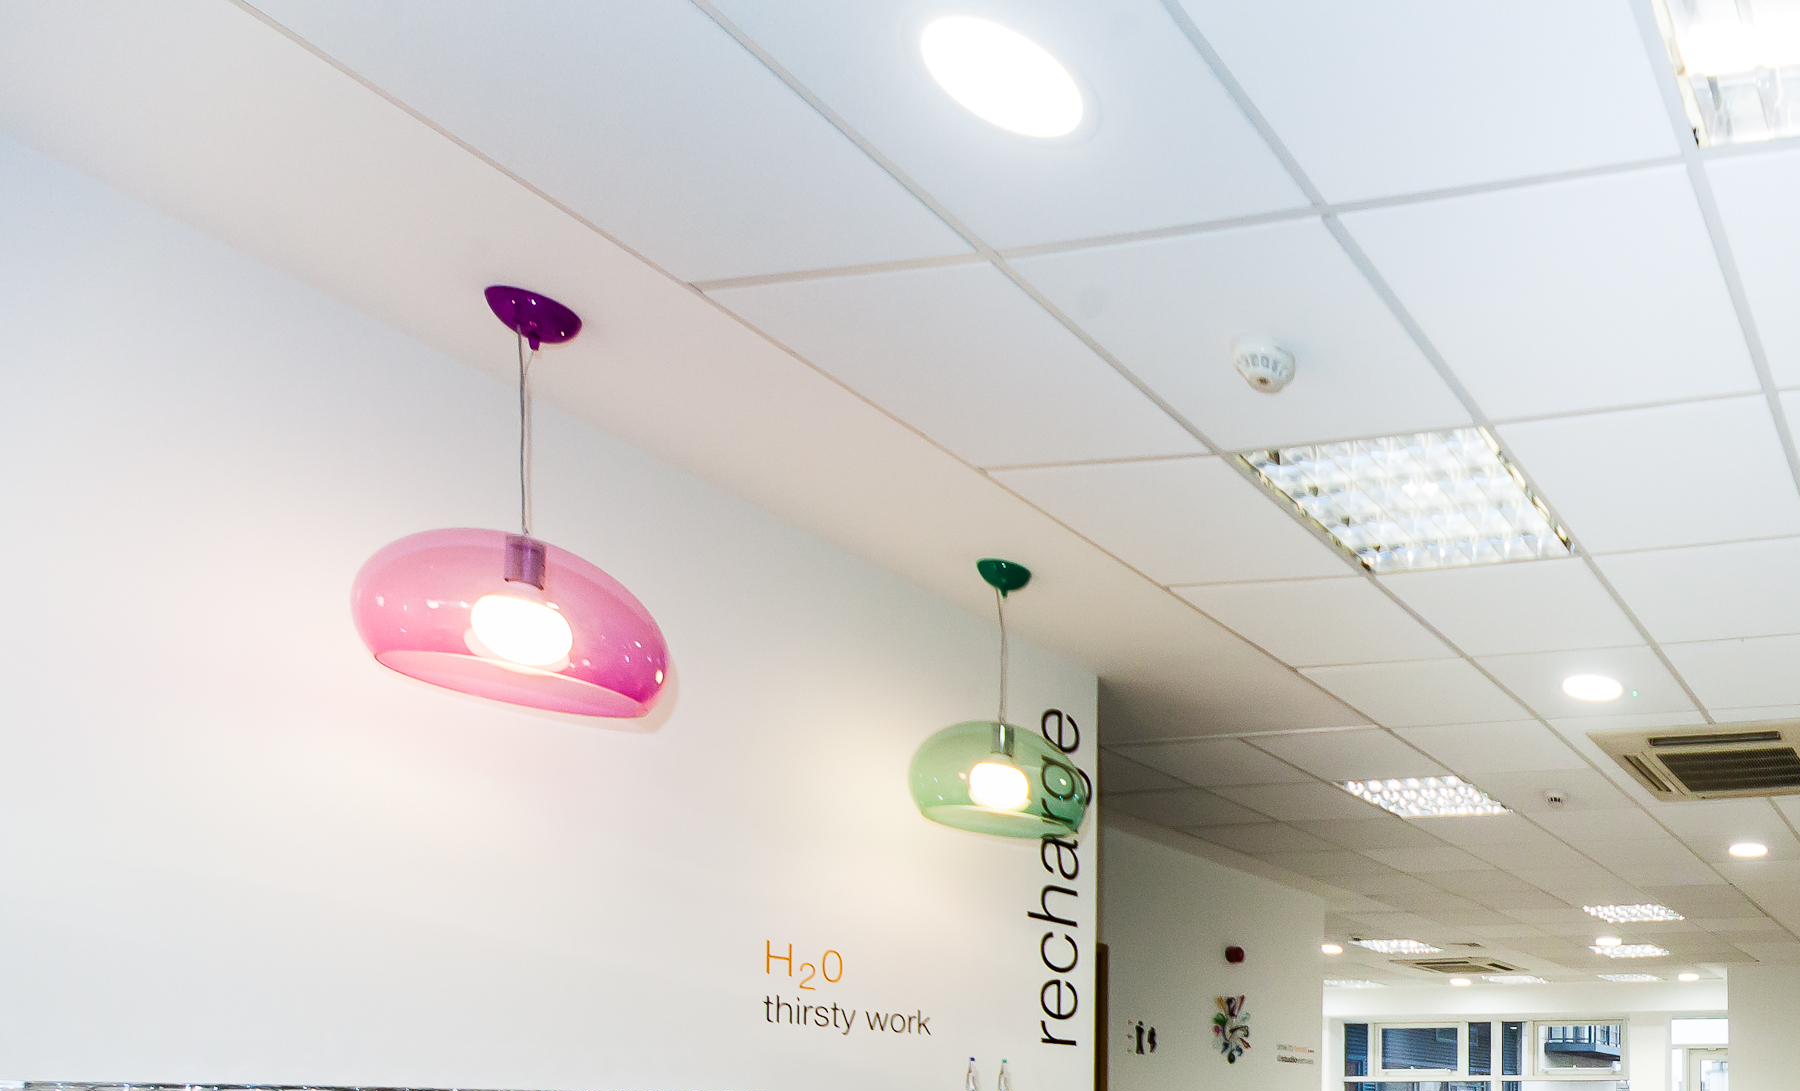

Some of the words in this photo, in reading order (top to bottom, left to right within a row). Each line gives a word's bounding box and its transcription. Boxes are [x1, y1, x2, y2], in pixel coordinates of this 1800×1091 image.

[1027, 708, 1092, 1046] recharge
[763, 994, 855, 1035] thirsty
[866, 1009, 931, 1035] work
